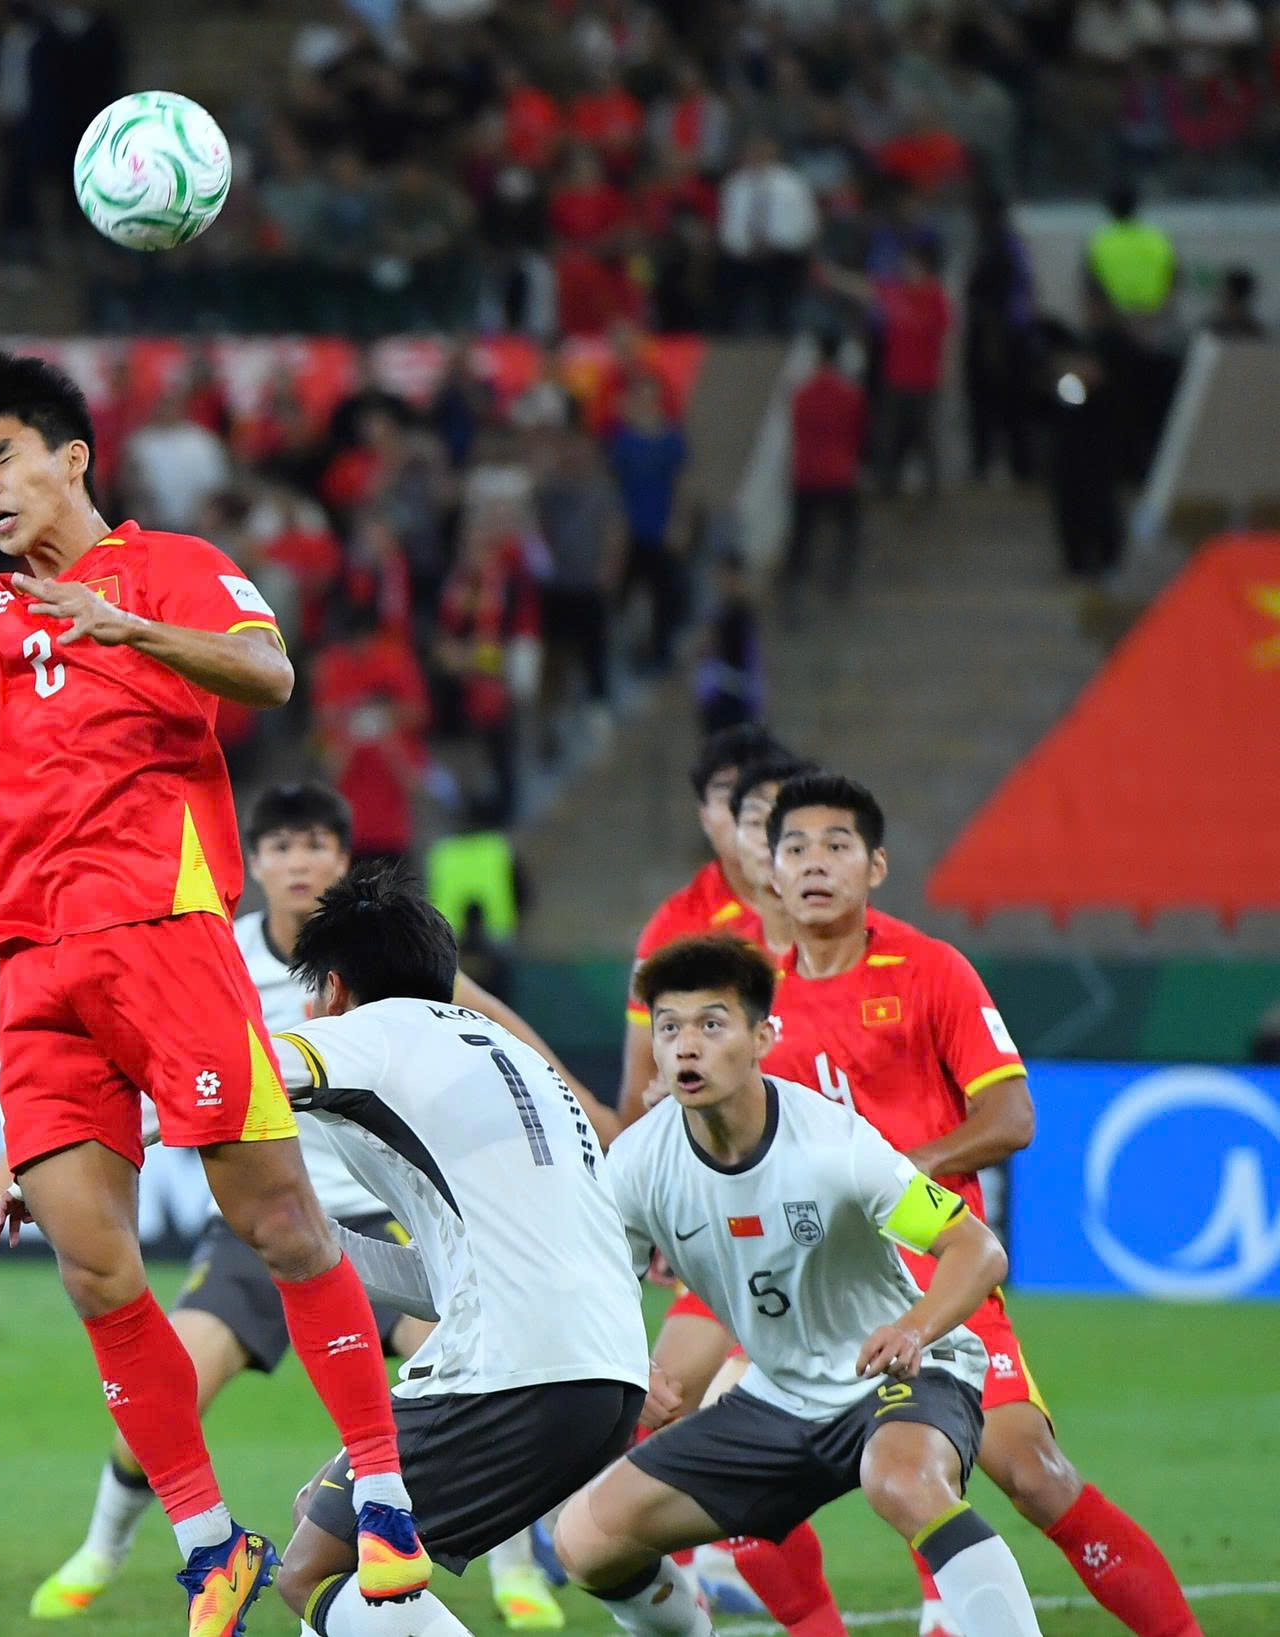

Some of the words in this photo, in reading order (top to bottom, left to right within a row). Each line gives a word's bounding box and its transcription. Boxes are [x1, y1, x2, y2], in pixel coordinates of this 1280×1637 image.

[22, 629, 66, 699] 2
[814, 1050, 857, 1113] 4
[747, 1270, 791, 1318] 5
